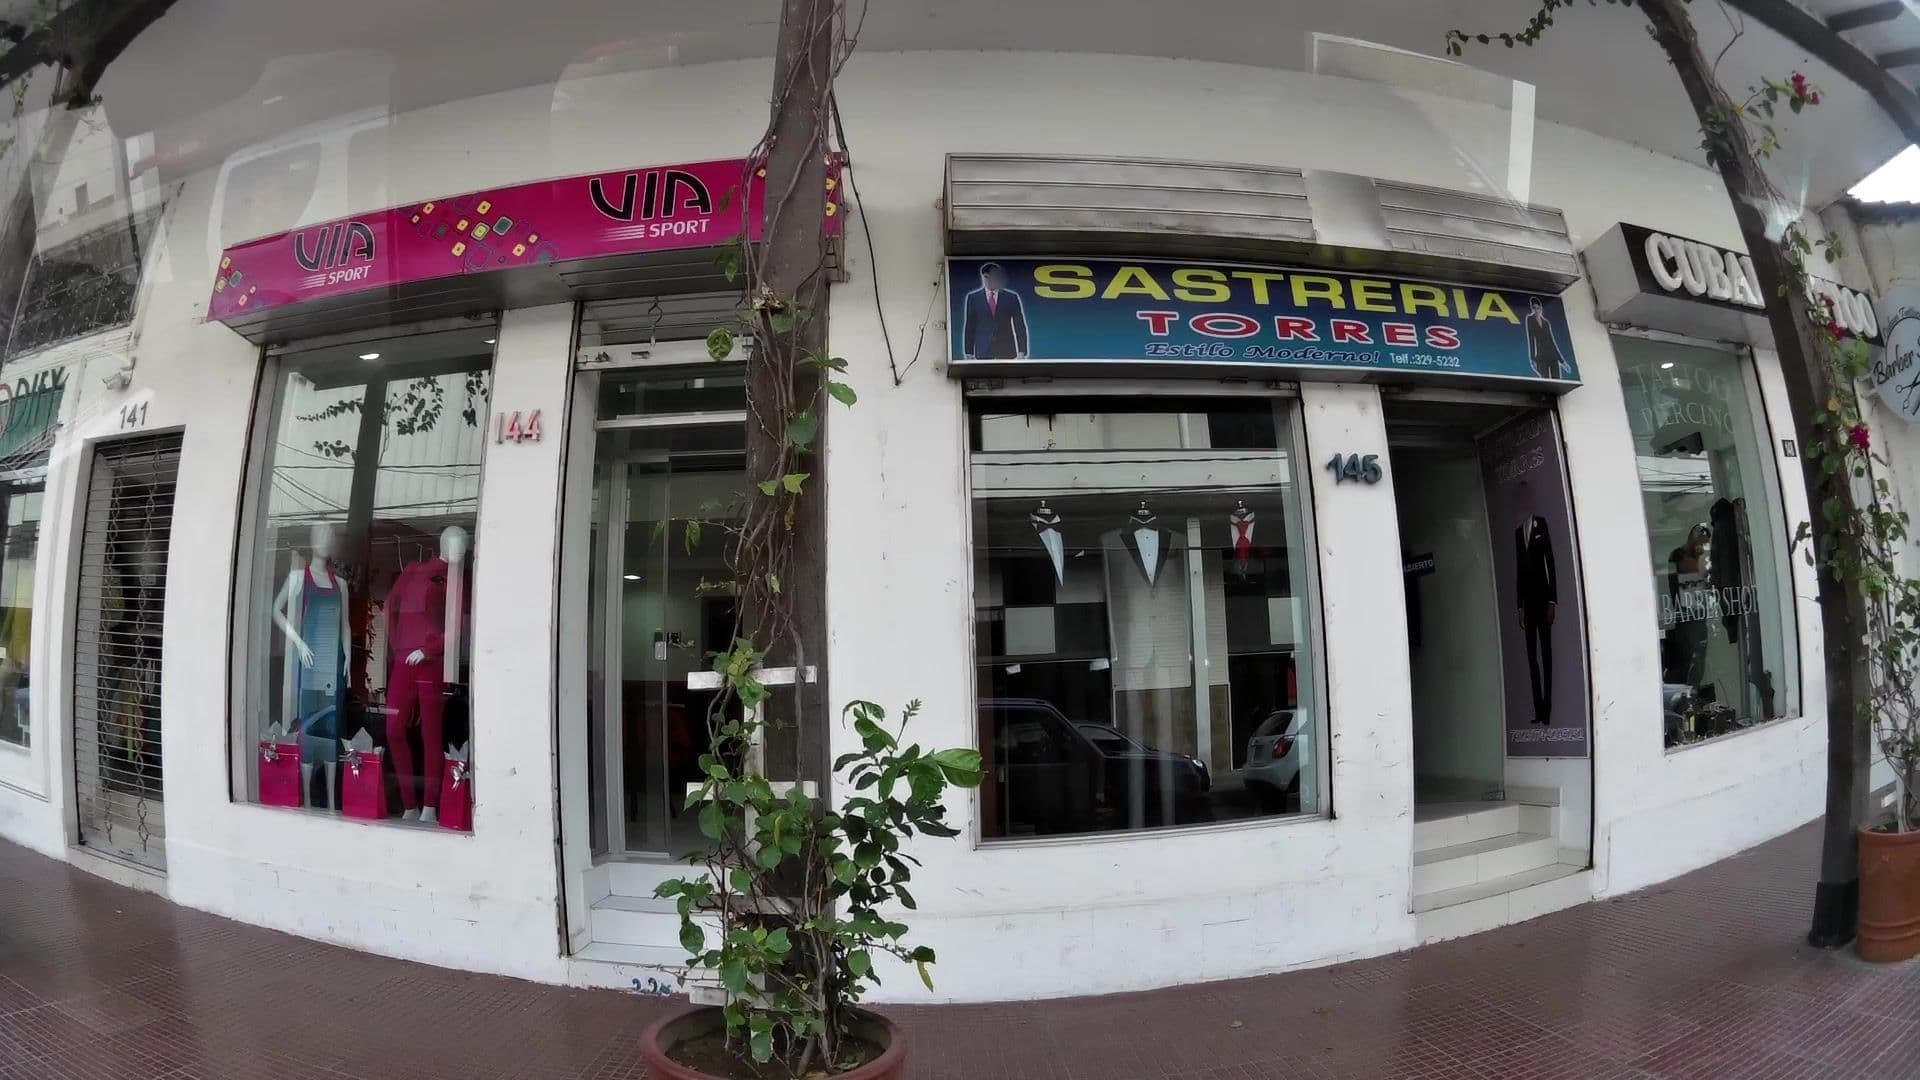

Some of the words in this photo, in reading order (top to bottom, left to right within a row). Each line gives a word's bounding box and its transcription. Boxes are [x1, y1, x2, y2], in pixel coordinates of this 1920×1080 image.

[589, 170, 712, 221] VIA
[648, 218, 710, 238] SPORT
[295, 222, 375, 271] VIA
[328, 265, 371, 285] SPORT
[1033, 264, 1521, 325] SASTRERIA
[1136, 311, 1461, 349] TORRES
[1145, 342, 1235, 359] Estilo
[1243, 345, 1380, 364] Moderno!
[1872, 344, 1914, 385] Barber
[119, 400, 149, 430] 141
[495, 409, 541, 444] 144
[1325, 453, 1382, 485] 145
